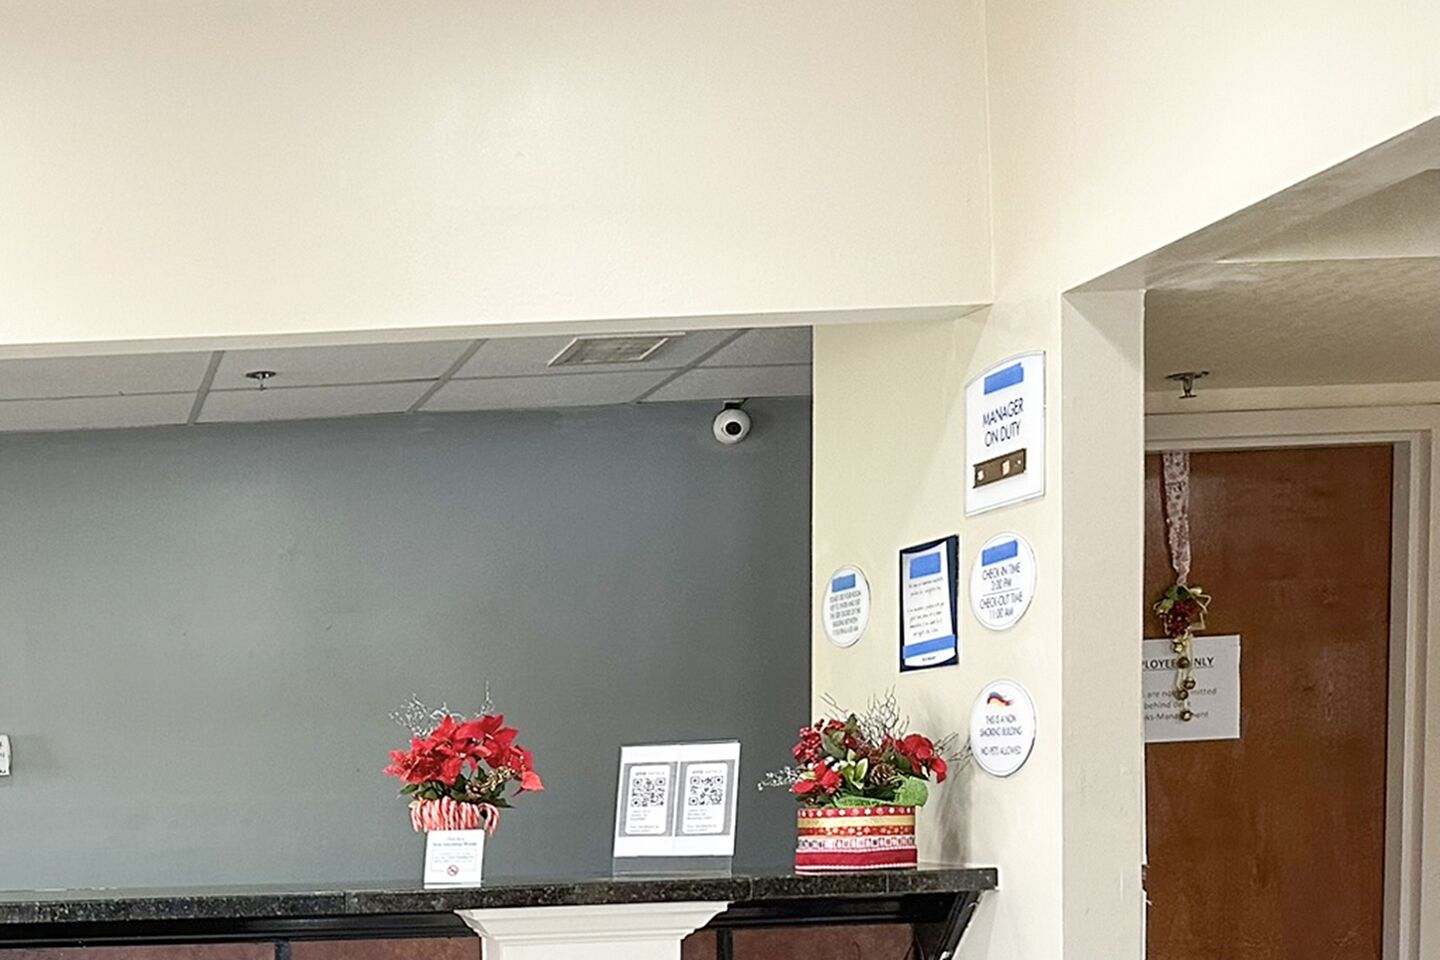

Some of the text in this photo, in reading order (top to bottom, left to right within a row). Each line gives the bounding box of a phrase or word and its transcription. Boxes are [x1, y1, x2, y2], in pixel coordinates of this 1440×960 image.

[982, 397, 1024, 427] MANAGER
[985, 420, 1022, 447] ON DUTY
[979, 597, 998, 610] CHECK
[1194, 656, 1214, 668] NLY
